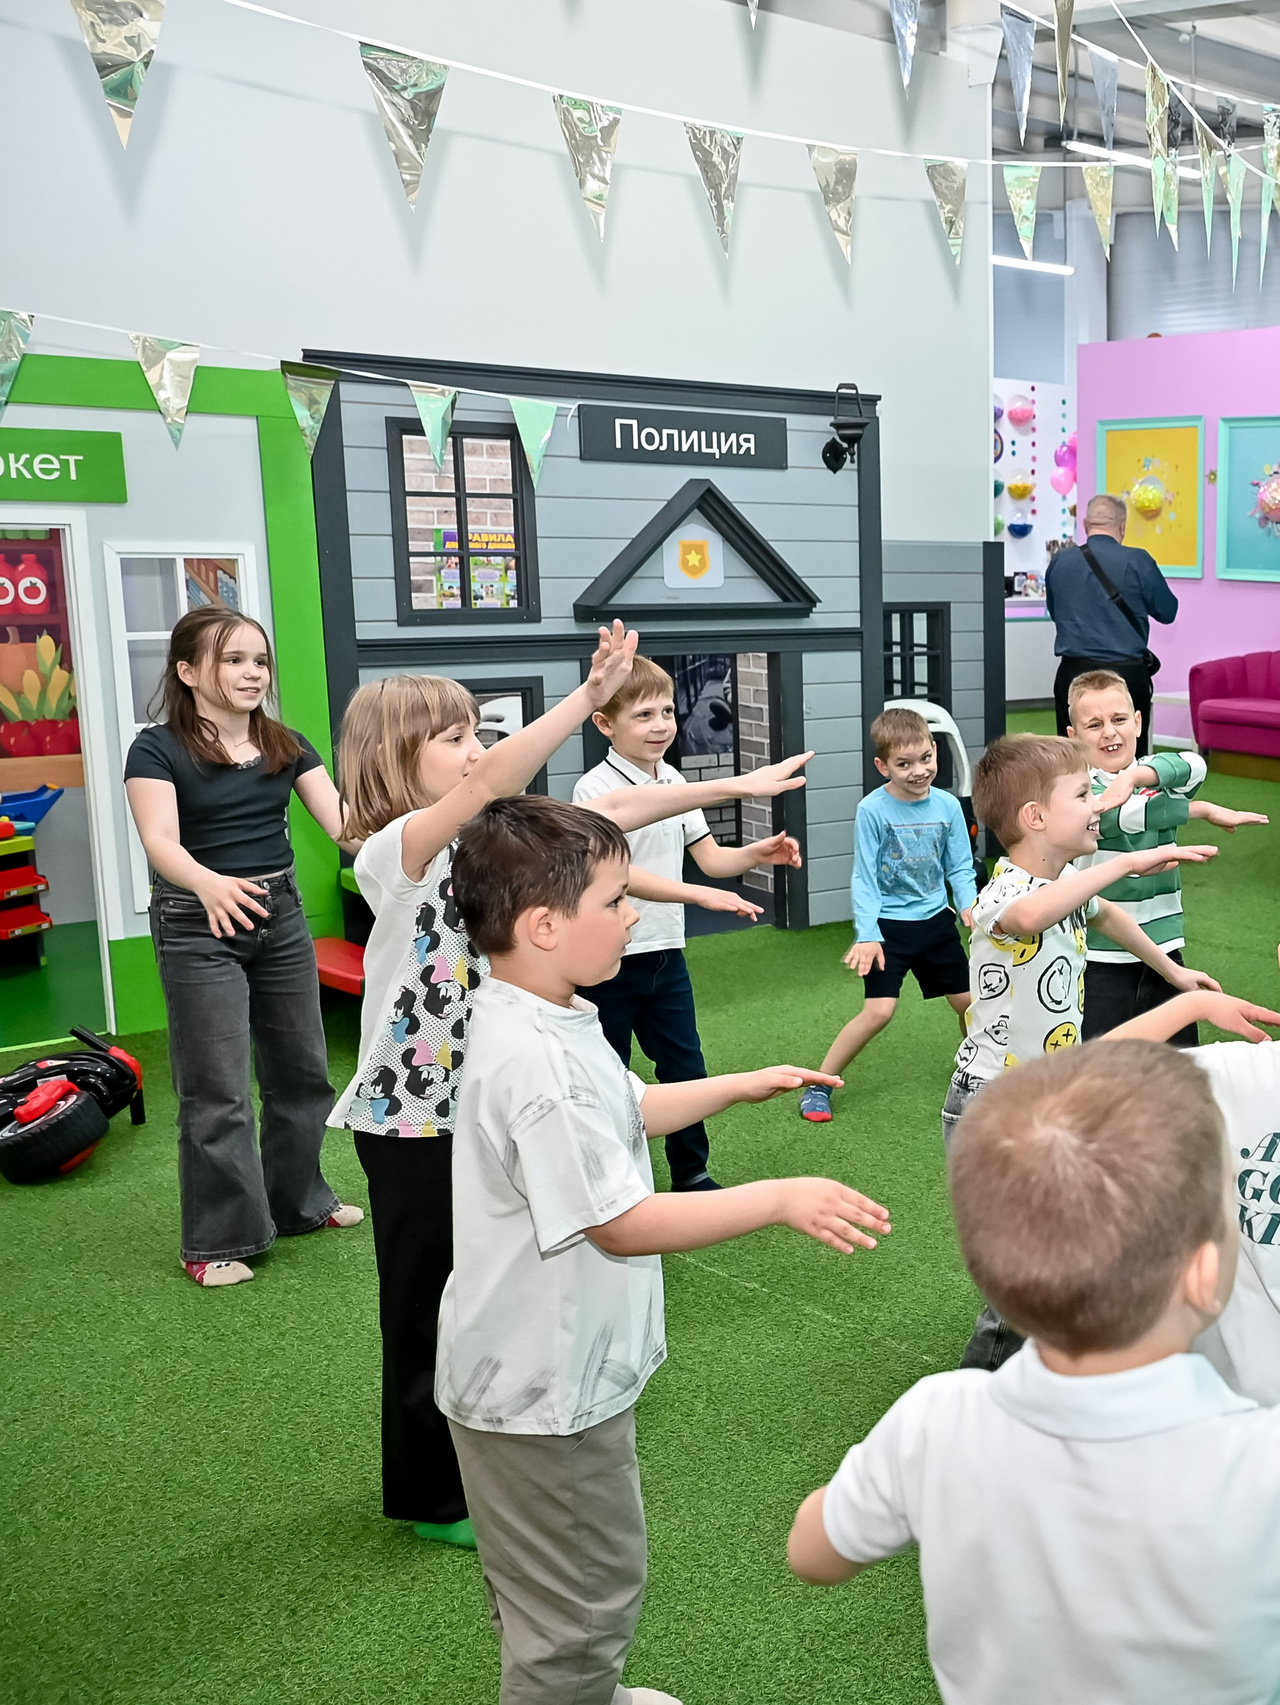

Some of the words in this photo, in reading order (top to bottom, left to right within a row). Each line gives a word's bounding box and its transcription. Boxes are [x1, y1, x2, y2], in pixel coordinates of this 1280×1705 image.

[615, 418, 756, 459] Полиция
[0, 453, 84, 480] кет
[468, 532, 515, 543] РАВИЛА
